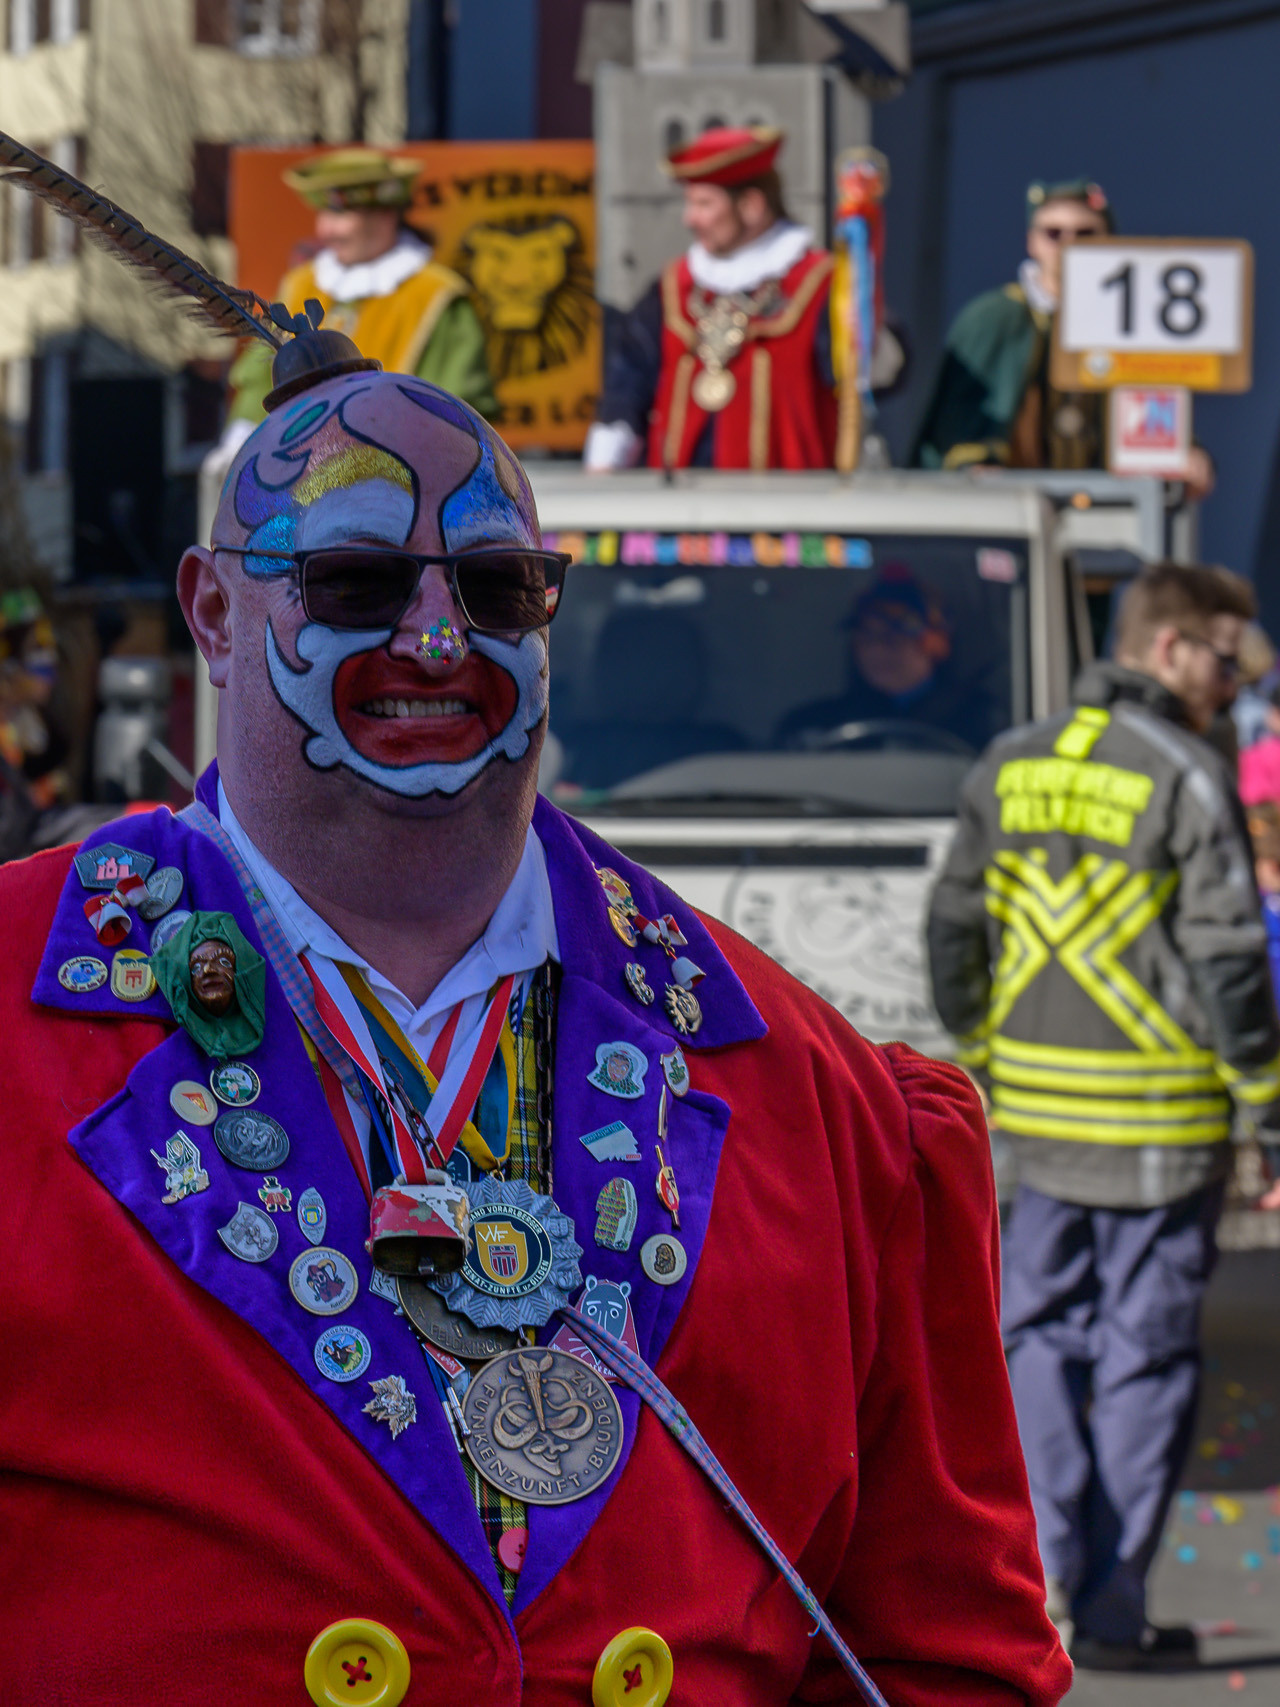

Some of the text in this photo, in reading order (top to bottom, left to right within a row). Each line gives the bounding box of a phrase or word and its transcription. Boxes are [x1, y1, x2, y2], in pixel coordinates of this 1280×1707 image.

[1100, 260, 1206, 339] 18
[471, 1369, 612, 1495] FUNKENZUNFT BLUDENZ
